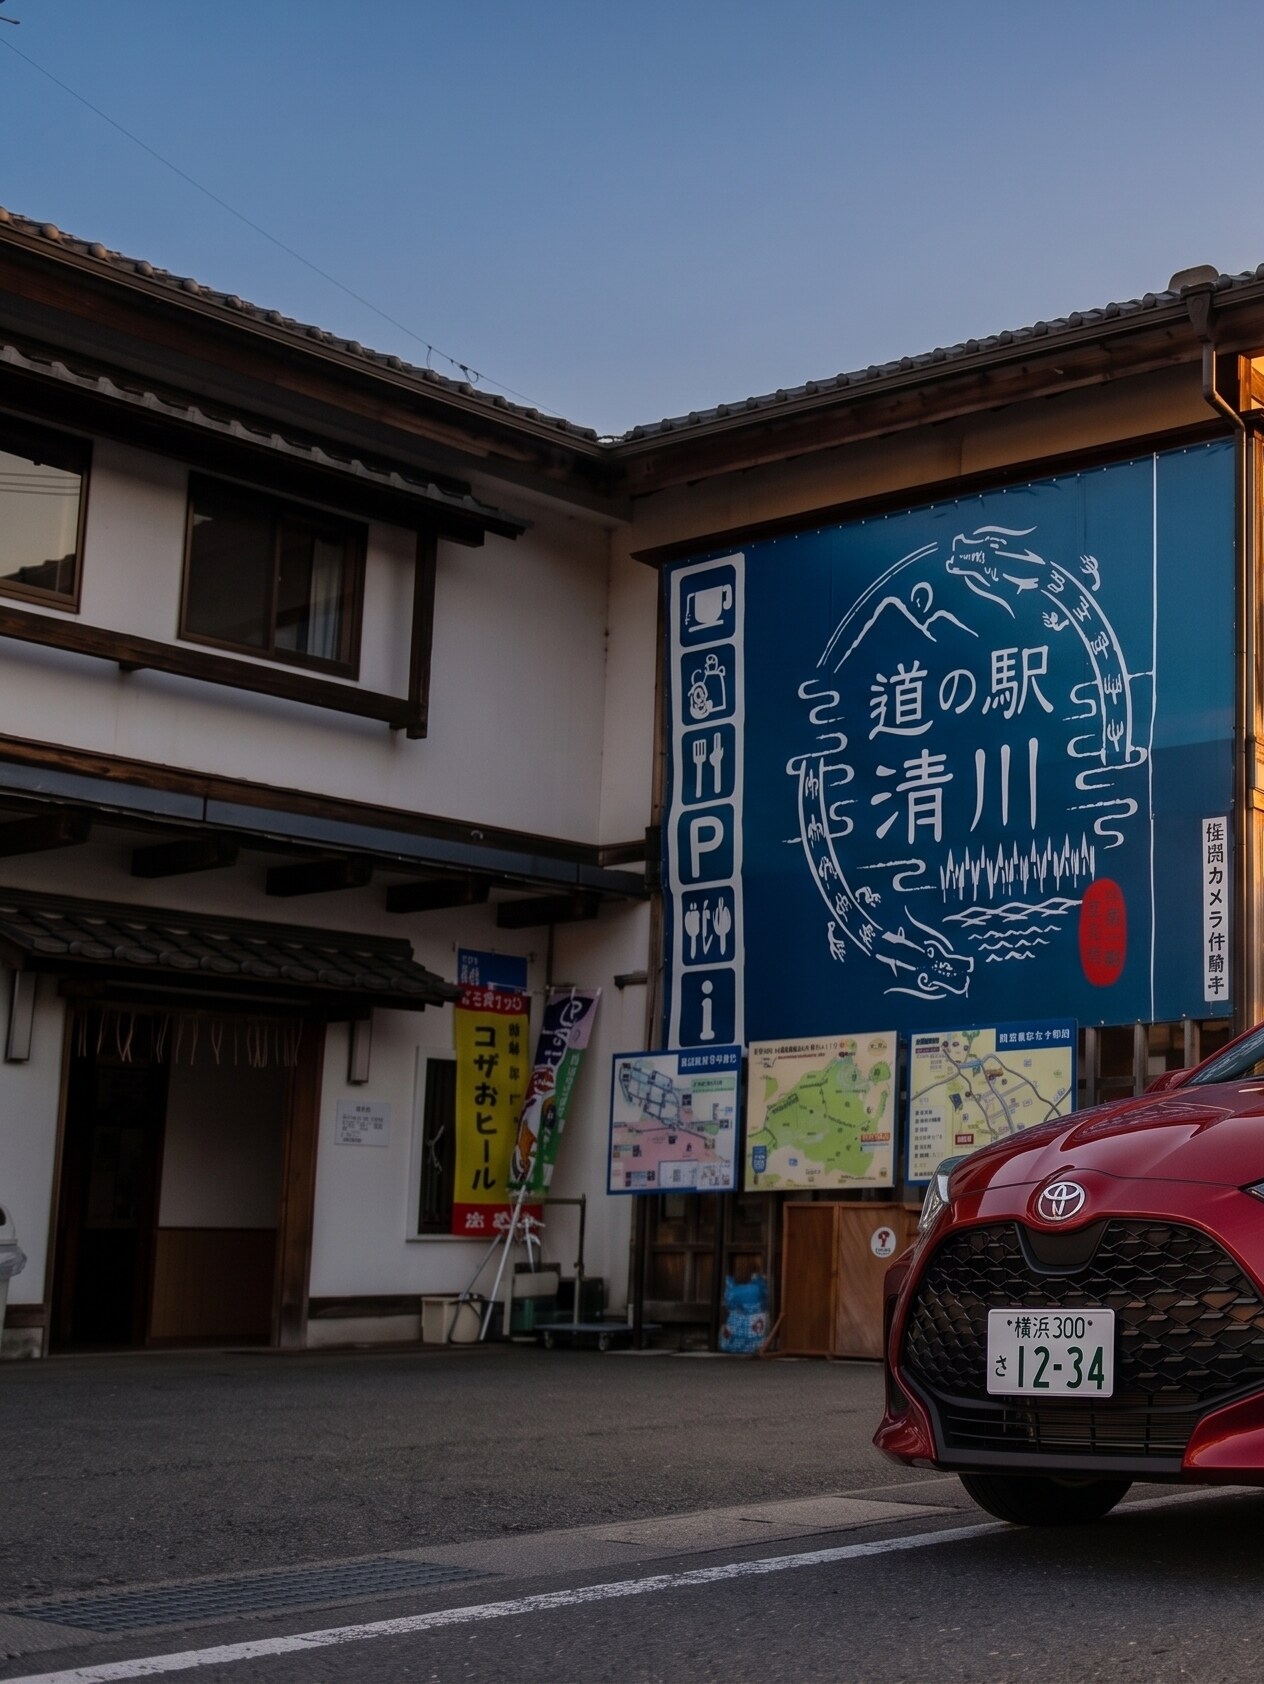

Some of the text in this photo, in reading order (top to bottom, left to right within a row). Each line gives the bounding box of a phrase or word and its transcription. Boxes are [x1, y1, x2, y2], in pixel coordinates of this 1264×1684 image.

[868, 645, 1054, 741] 道の駅
[868, 737, 1040, 846] 清川
[690, 816, 725, 878] P
[1014, 1316, 1085, 1339] 横浜 300
[995, 1345, 1105, 1390] さ 12-34
